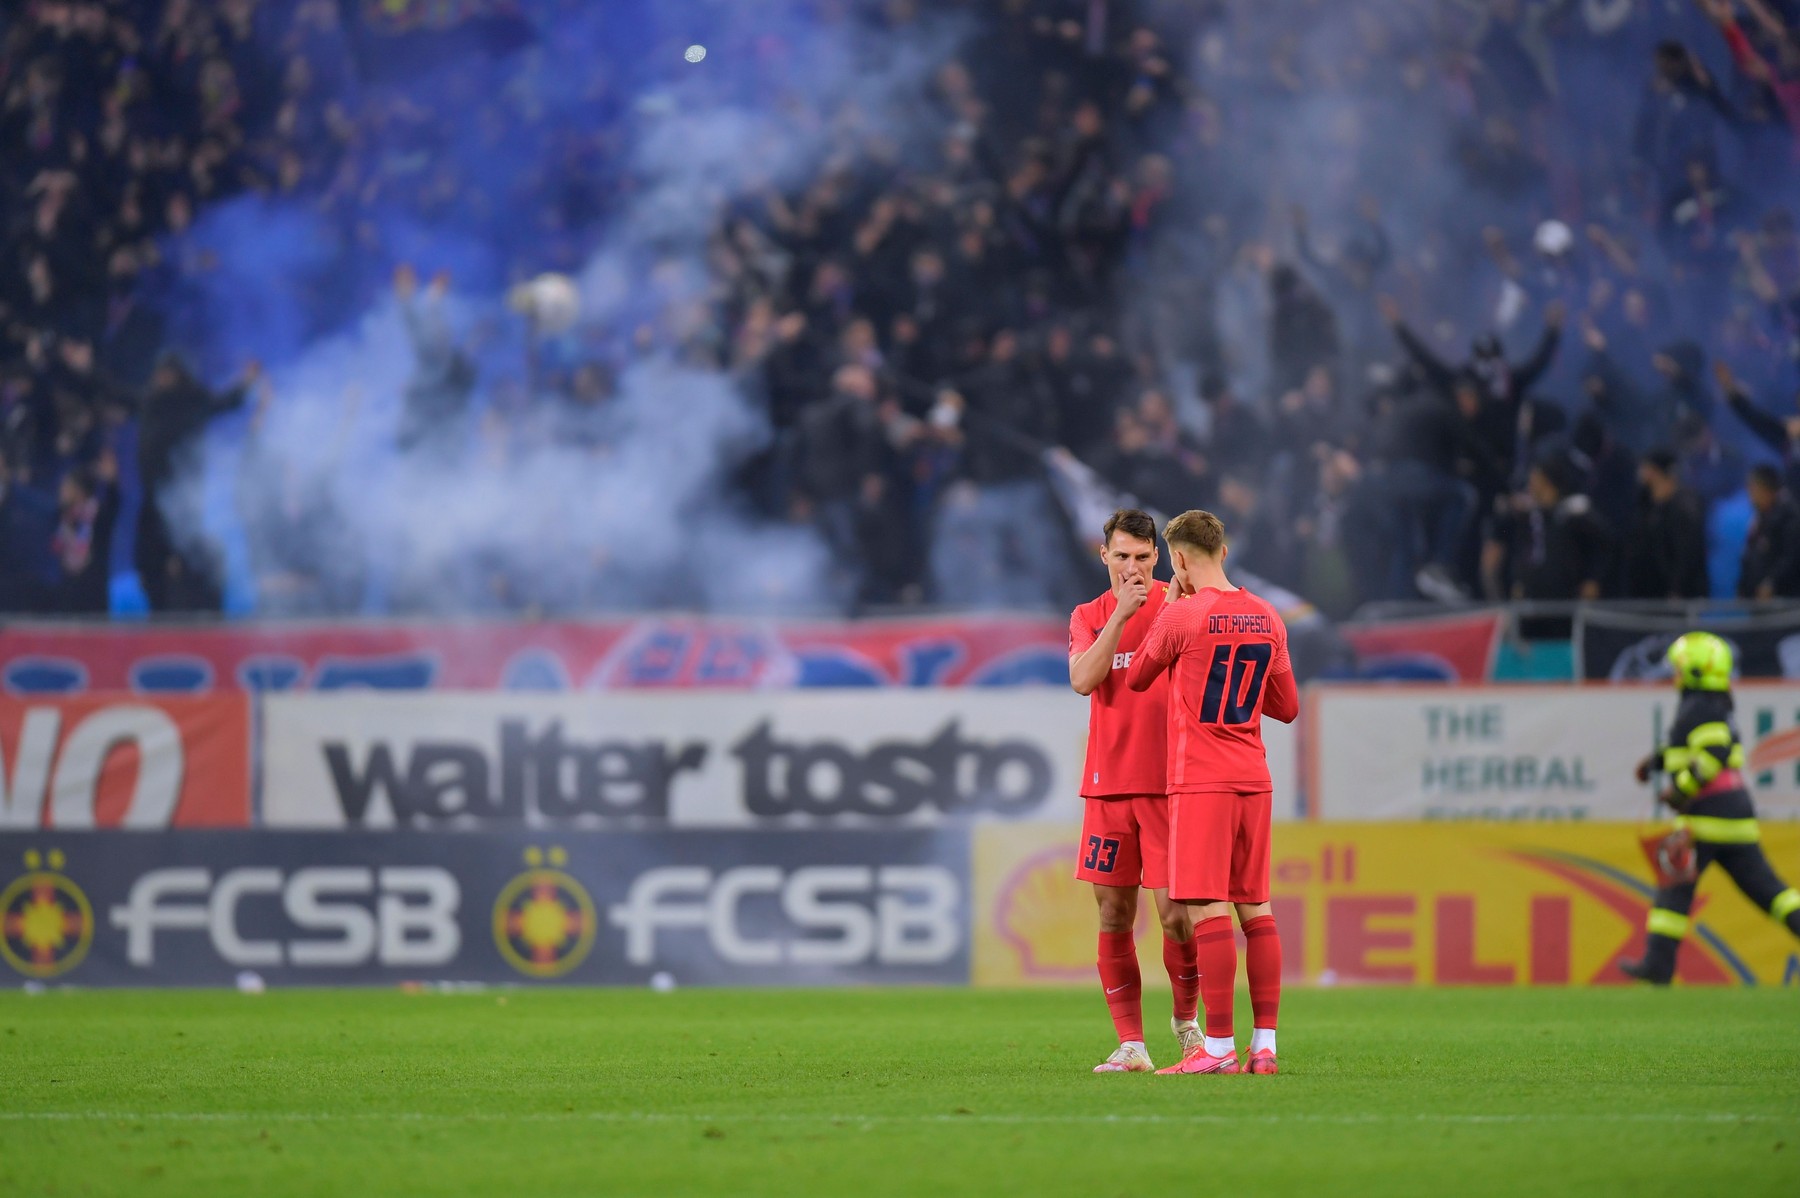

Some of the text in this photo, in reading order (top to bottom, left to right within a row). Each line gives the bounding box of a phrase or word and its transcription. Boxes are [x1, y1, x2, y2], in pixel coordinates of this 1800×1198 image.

[1200, 643, 1272, 724] 10
[1421, 704, 1503, 741] THE
[322, 717, 1054, 822] walter tosto
[1422, 756, 1595, 792] HERBAL
[1085, 835, 1119, 873] 33
[1277, 845, 1356, 883] ell
[110, 867, 460, 966] FCSB
[610, 867, 960, 966] FCSB
